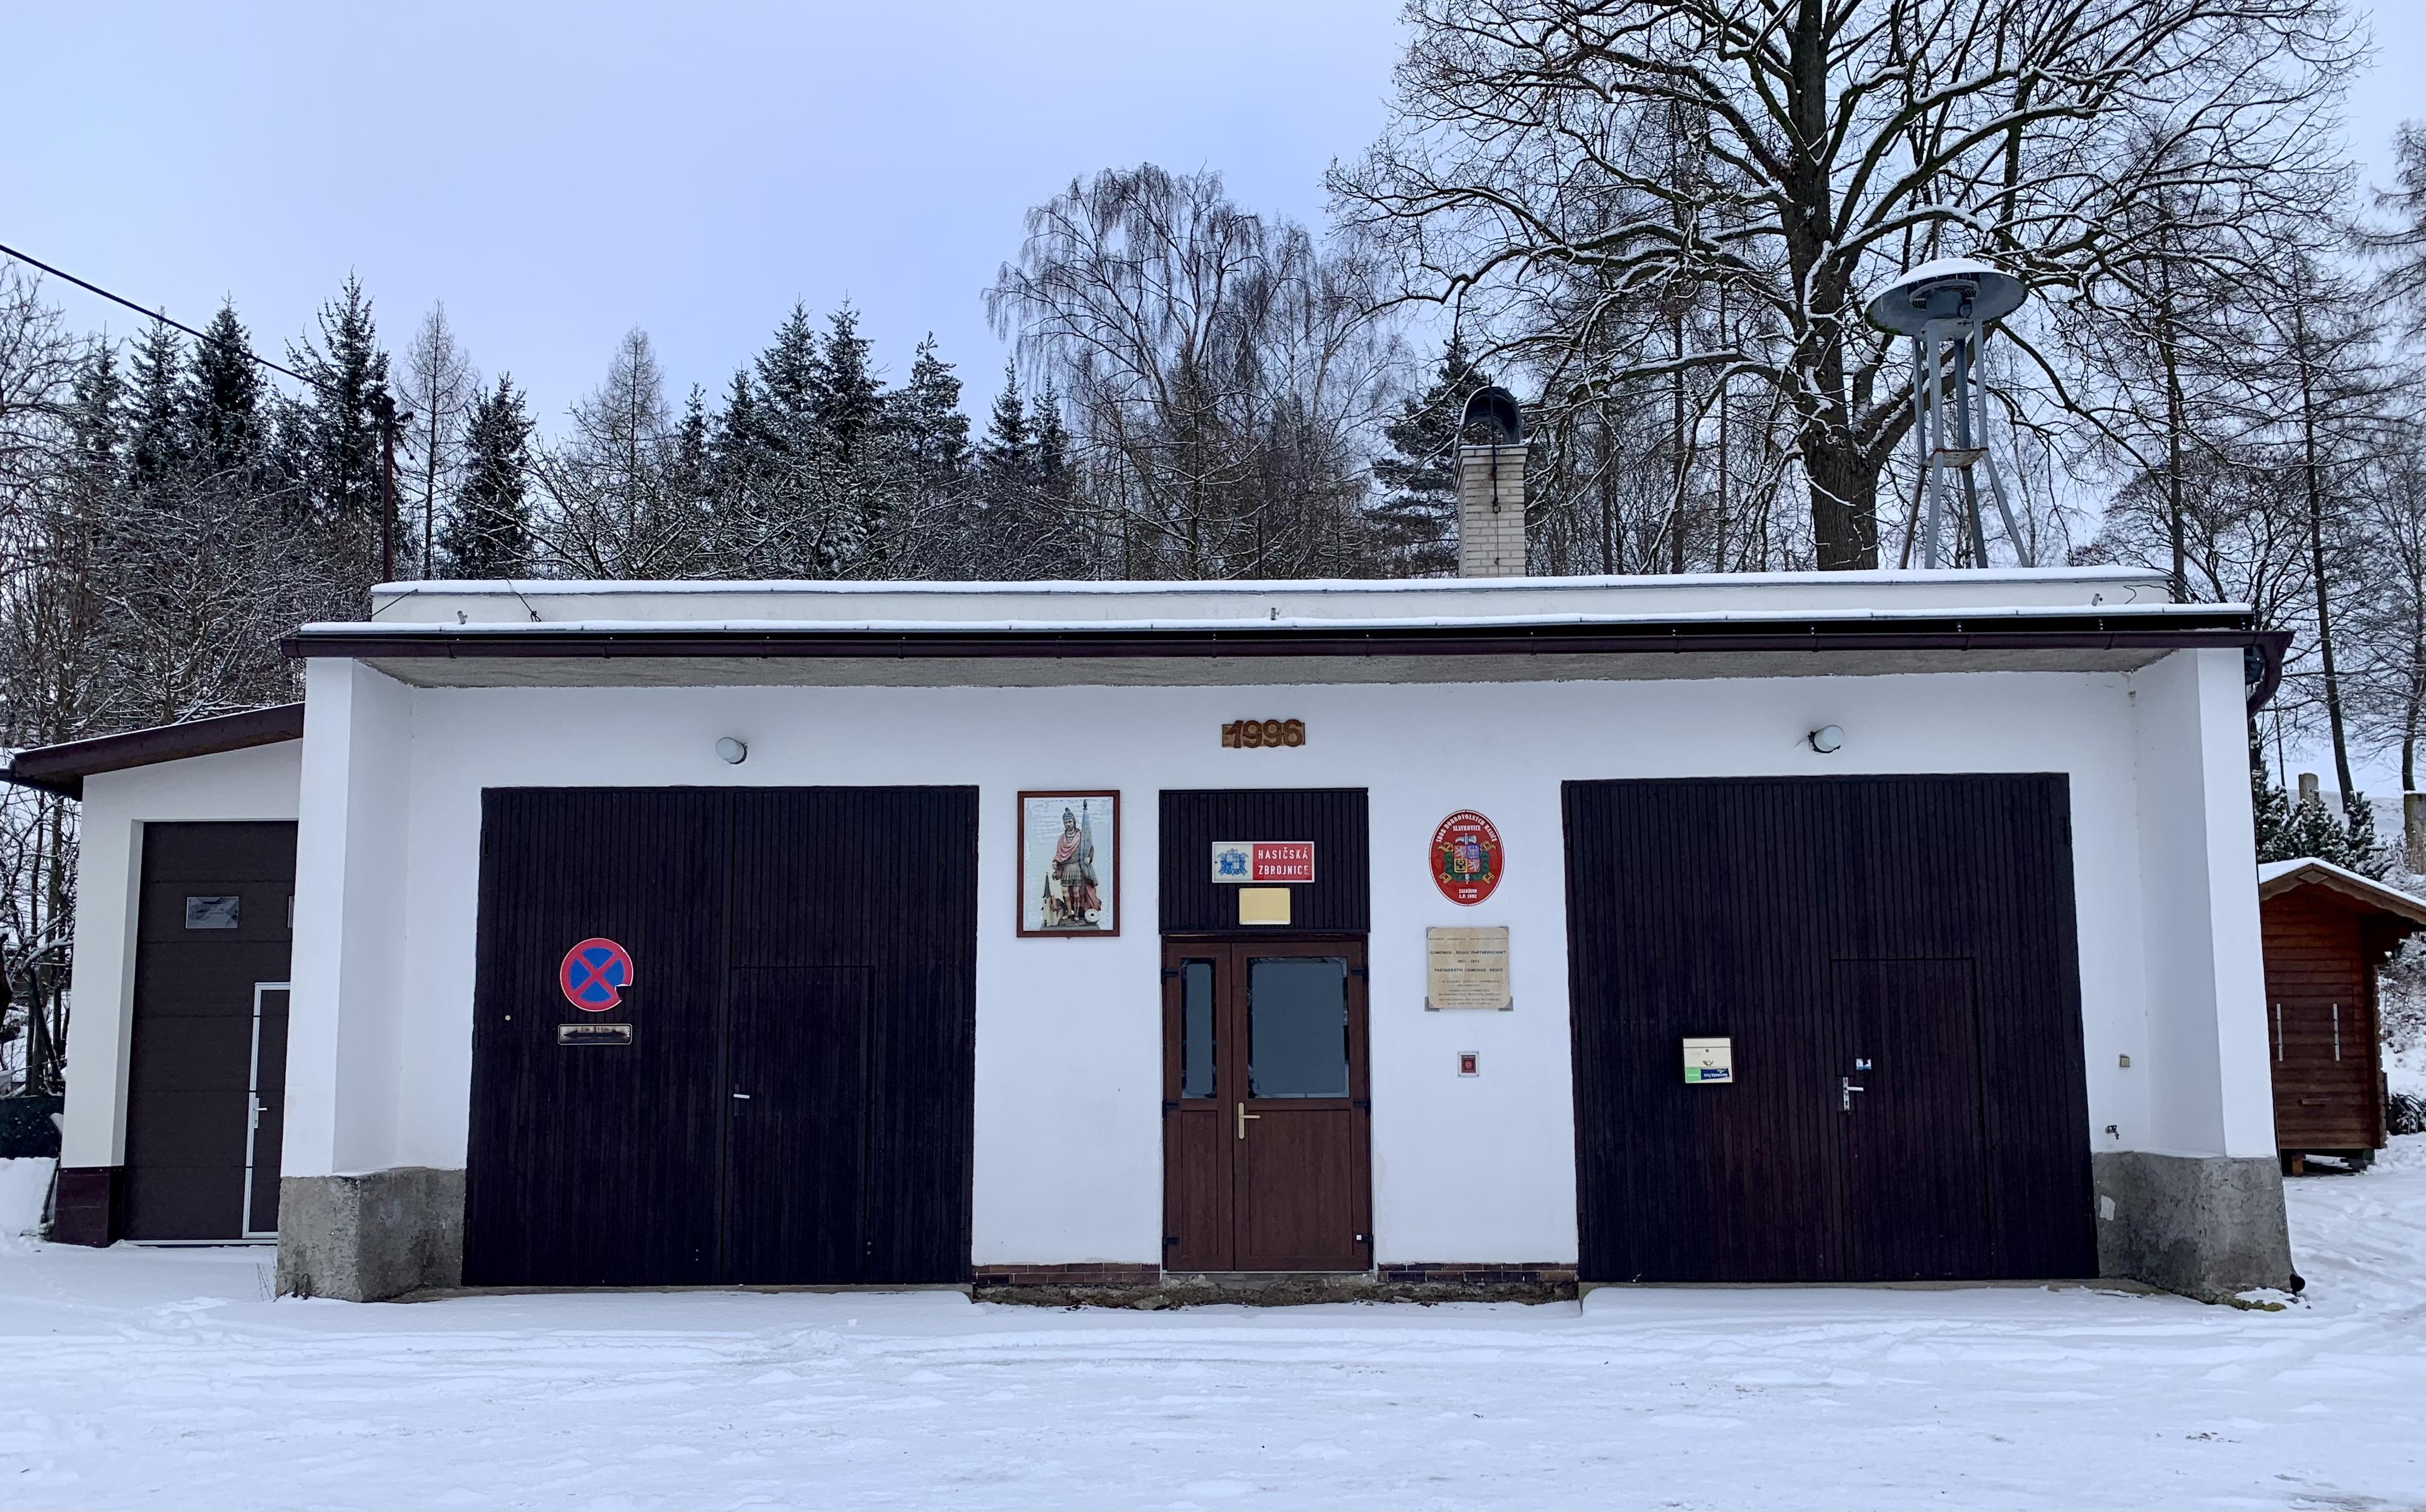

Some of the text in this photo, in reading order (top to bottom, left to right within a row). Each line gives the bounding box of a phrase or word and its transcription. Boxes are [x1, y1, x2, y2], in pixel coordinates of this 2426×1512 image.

[1225, 719, 1303, 748] 1996
[1258, 847, 1308, 859] HASIČSKÁ
[1258, 865, 1309, 875] ZBROJNICE
